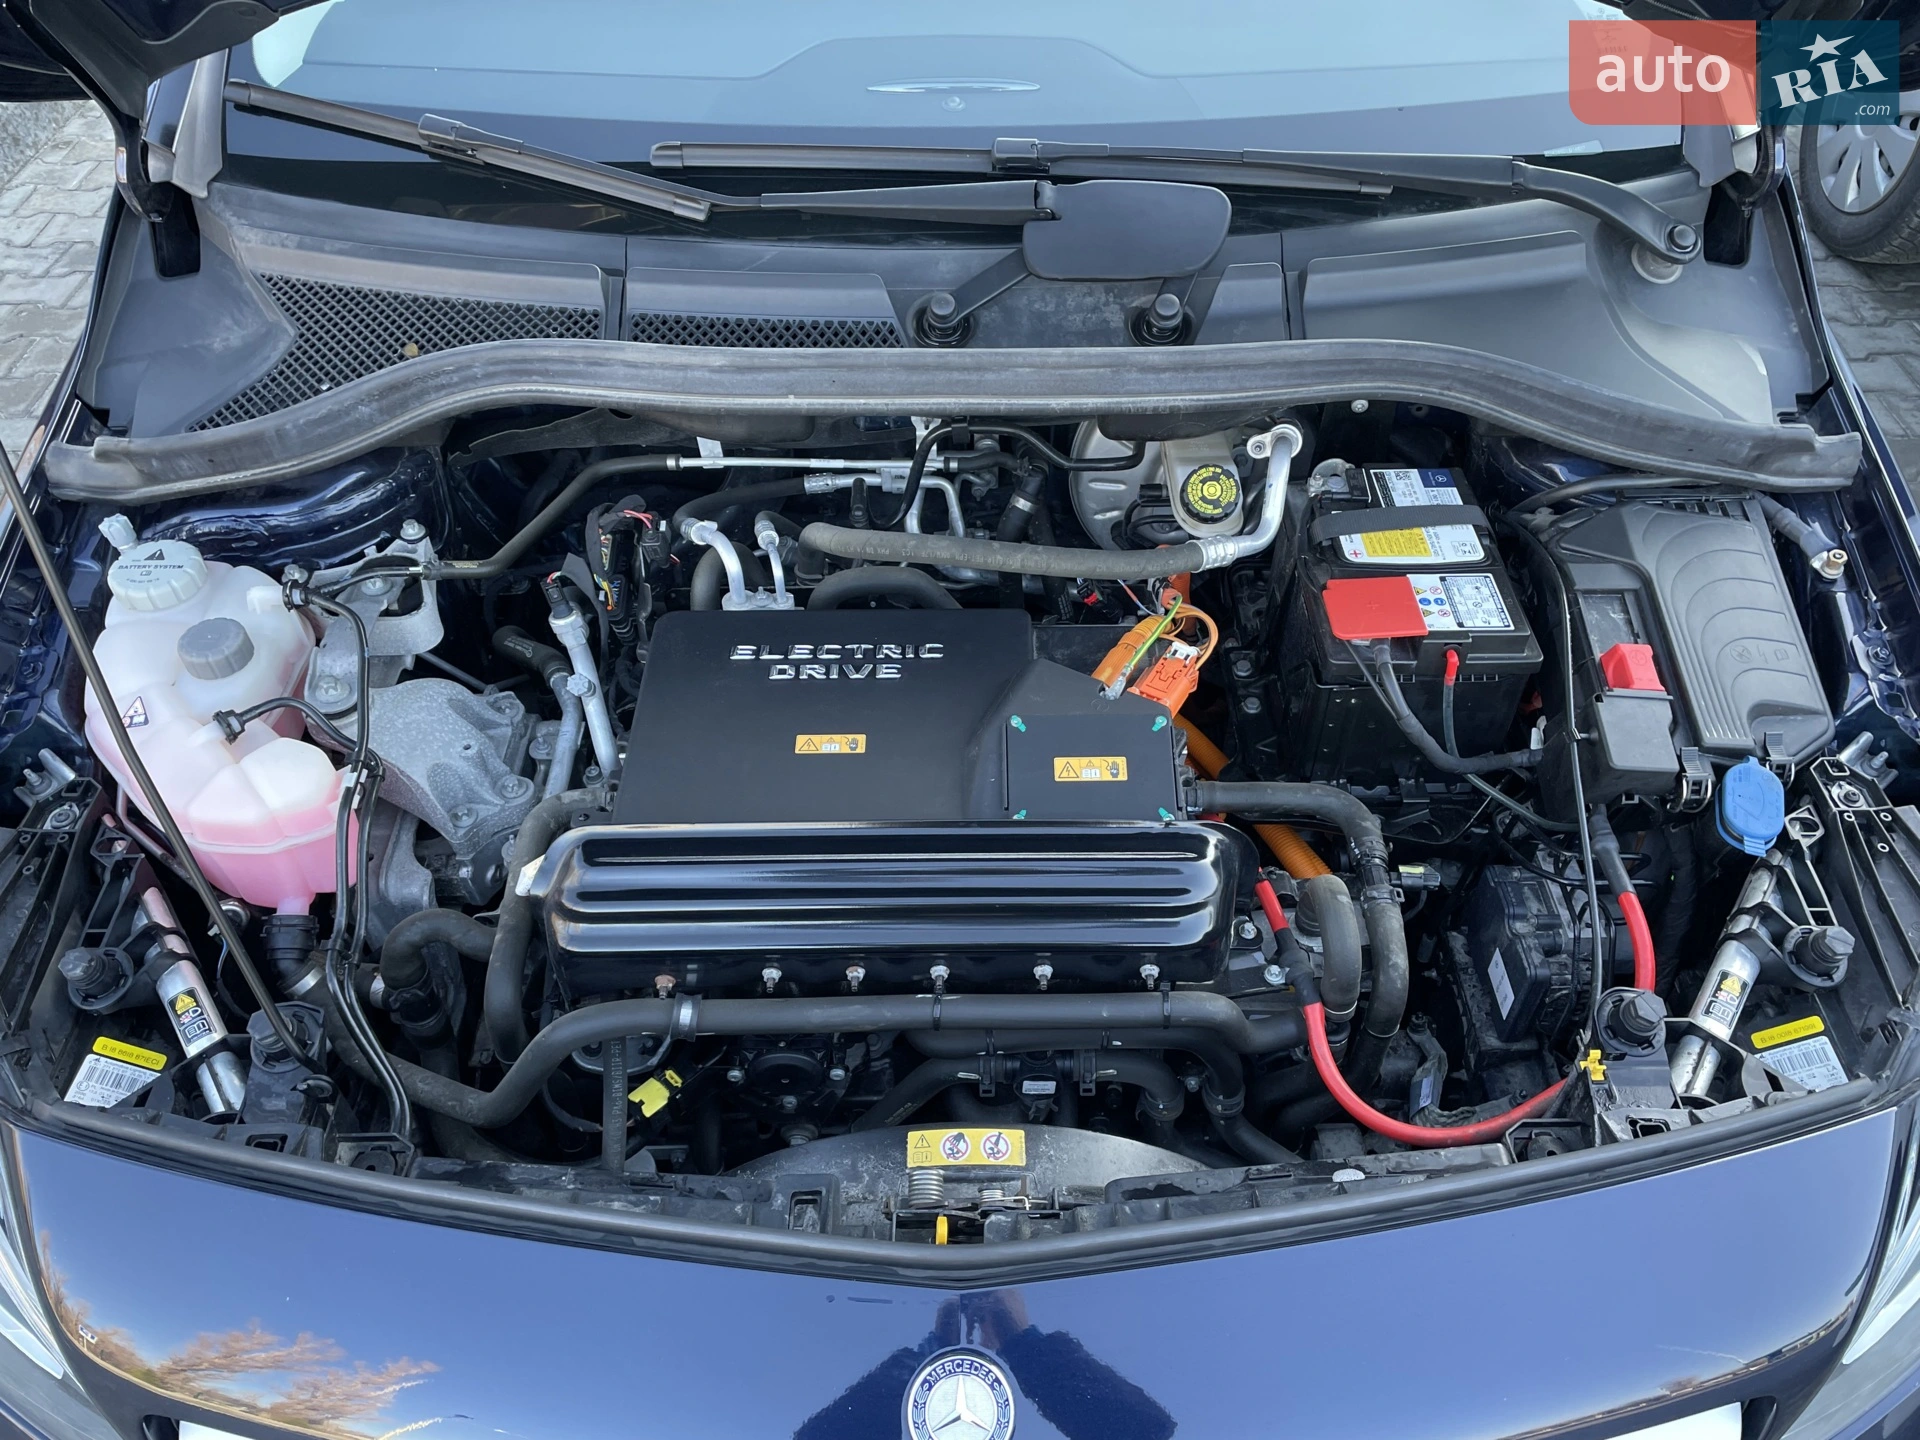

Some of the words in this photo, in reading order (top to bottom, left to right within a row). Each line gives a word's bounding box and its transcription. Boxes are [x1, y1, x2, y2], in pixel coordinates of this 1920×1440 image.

[729, 643, 944, 660] ELECTRIC
[768, 663, 902, 680] DRIVE
[926, 1359, 997, 1386] MERCEDES
